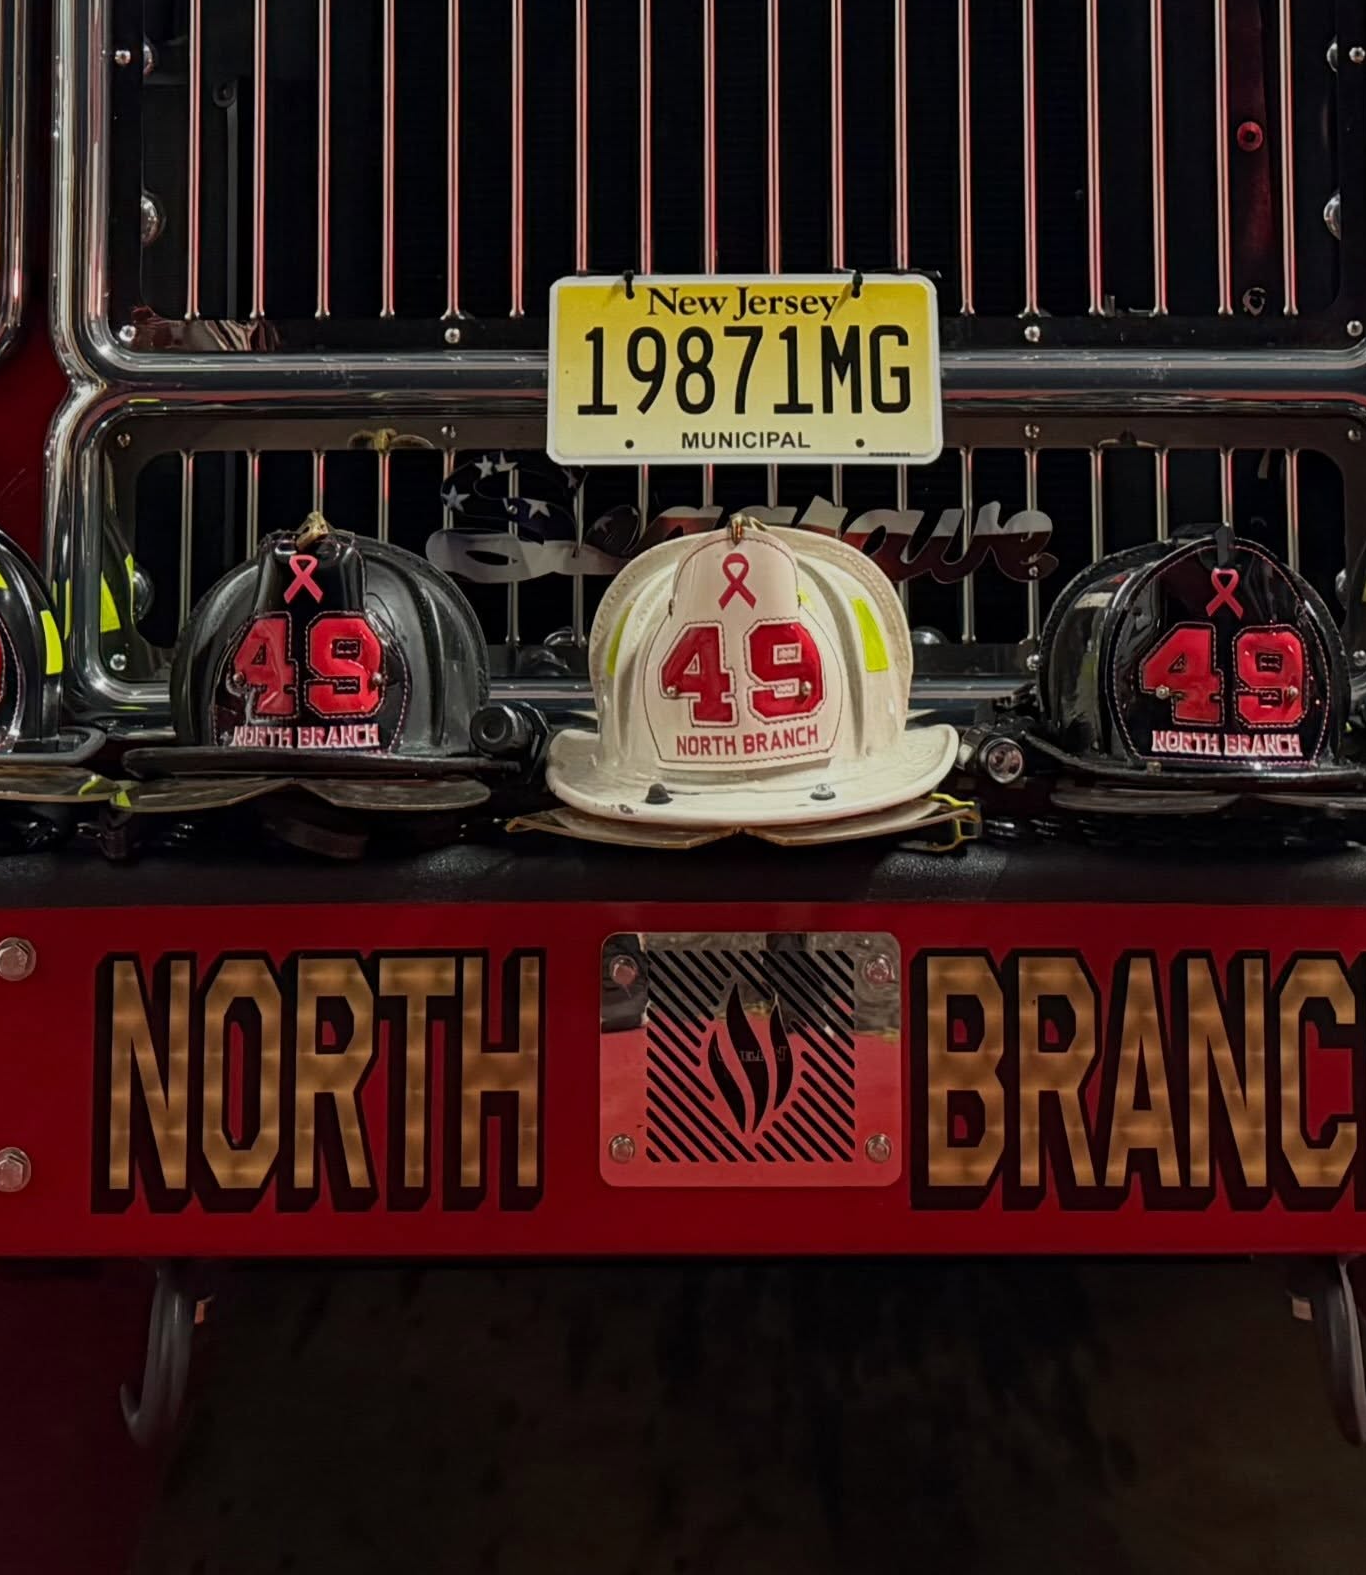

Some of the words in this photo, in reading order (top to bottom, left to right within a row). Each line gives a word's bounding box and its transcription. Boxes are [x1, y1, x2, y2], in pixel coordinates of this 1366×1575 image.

[647, 286, 728, 317] New
[733, 286, 839, 320] Jersey
[577, 325, 911, 415] 19871MG
[680, 431, 811, 450] MUNICIPAL
[233, 612, 386, 719] 49
[659, 617, 825, 727] 49
[1139, 623, 1308, 727] 49
[232, 725, 294, 748] NORTH
[297, 724, 379, 749] BRANCH
[675, 733, 737, 757] NORTH
[742, 726, 819, 754] BRANCH
[1151, 729, 1222, 755] NORTH
[1226, 731, 1301, 757] BRANCH
[91, 948, 547, 1214] NORTH
